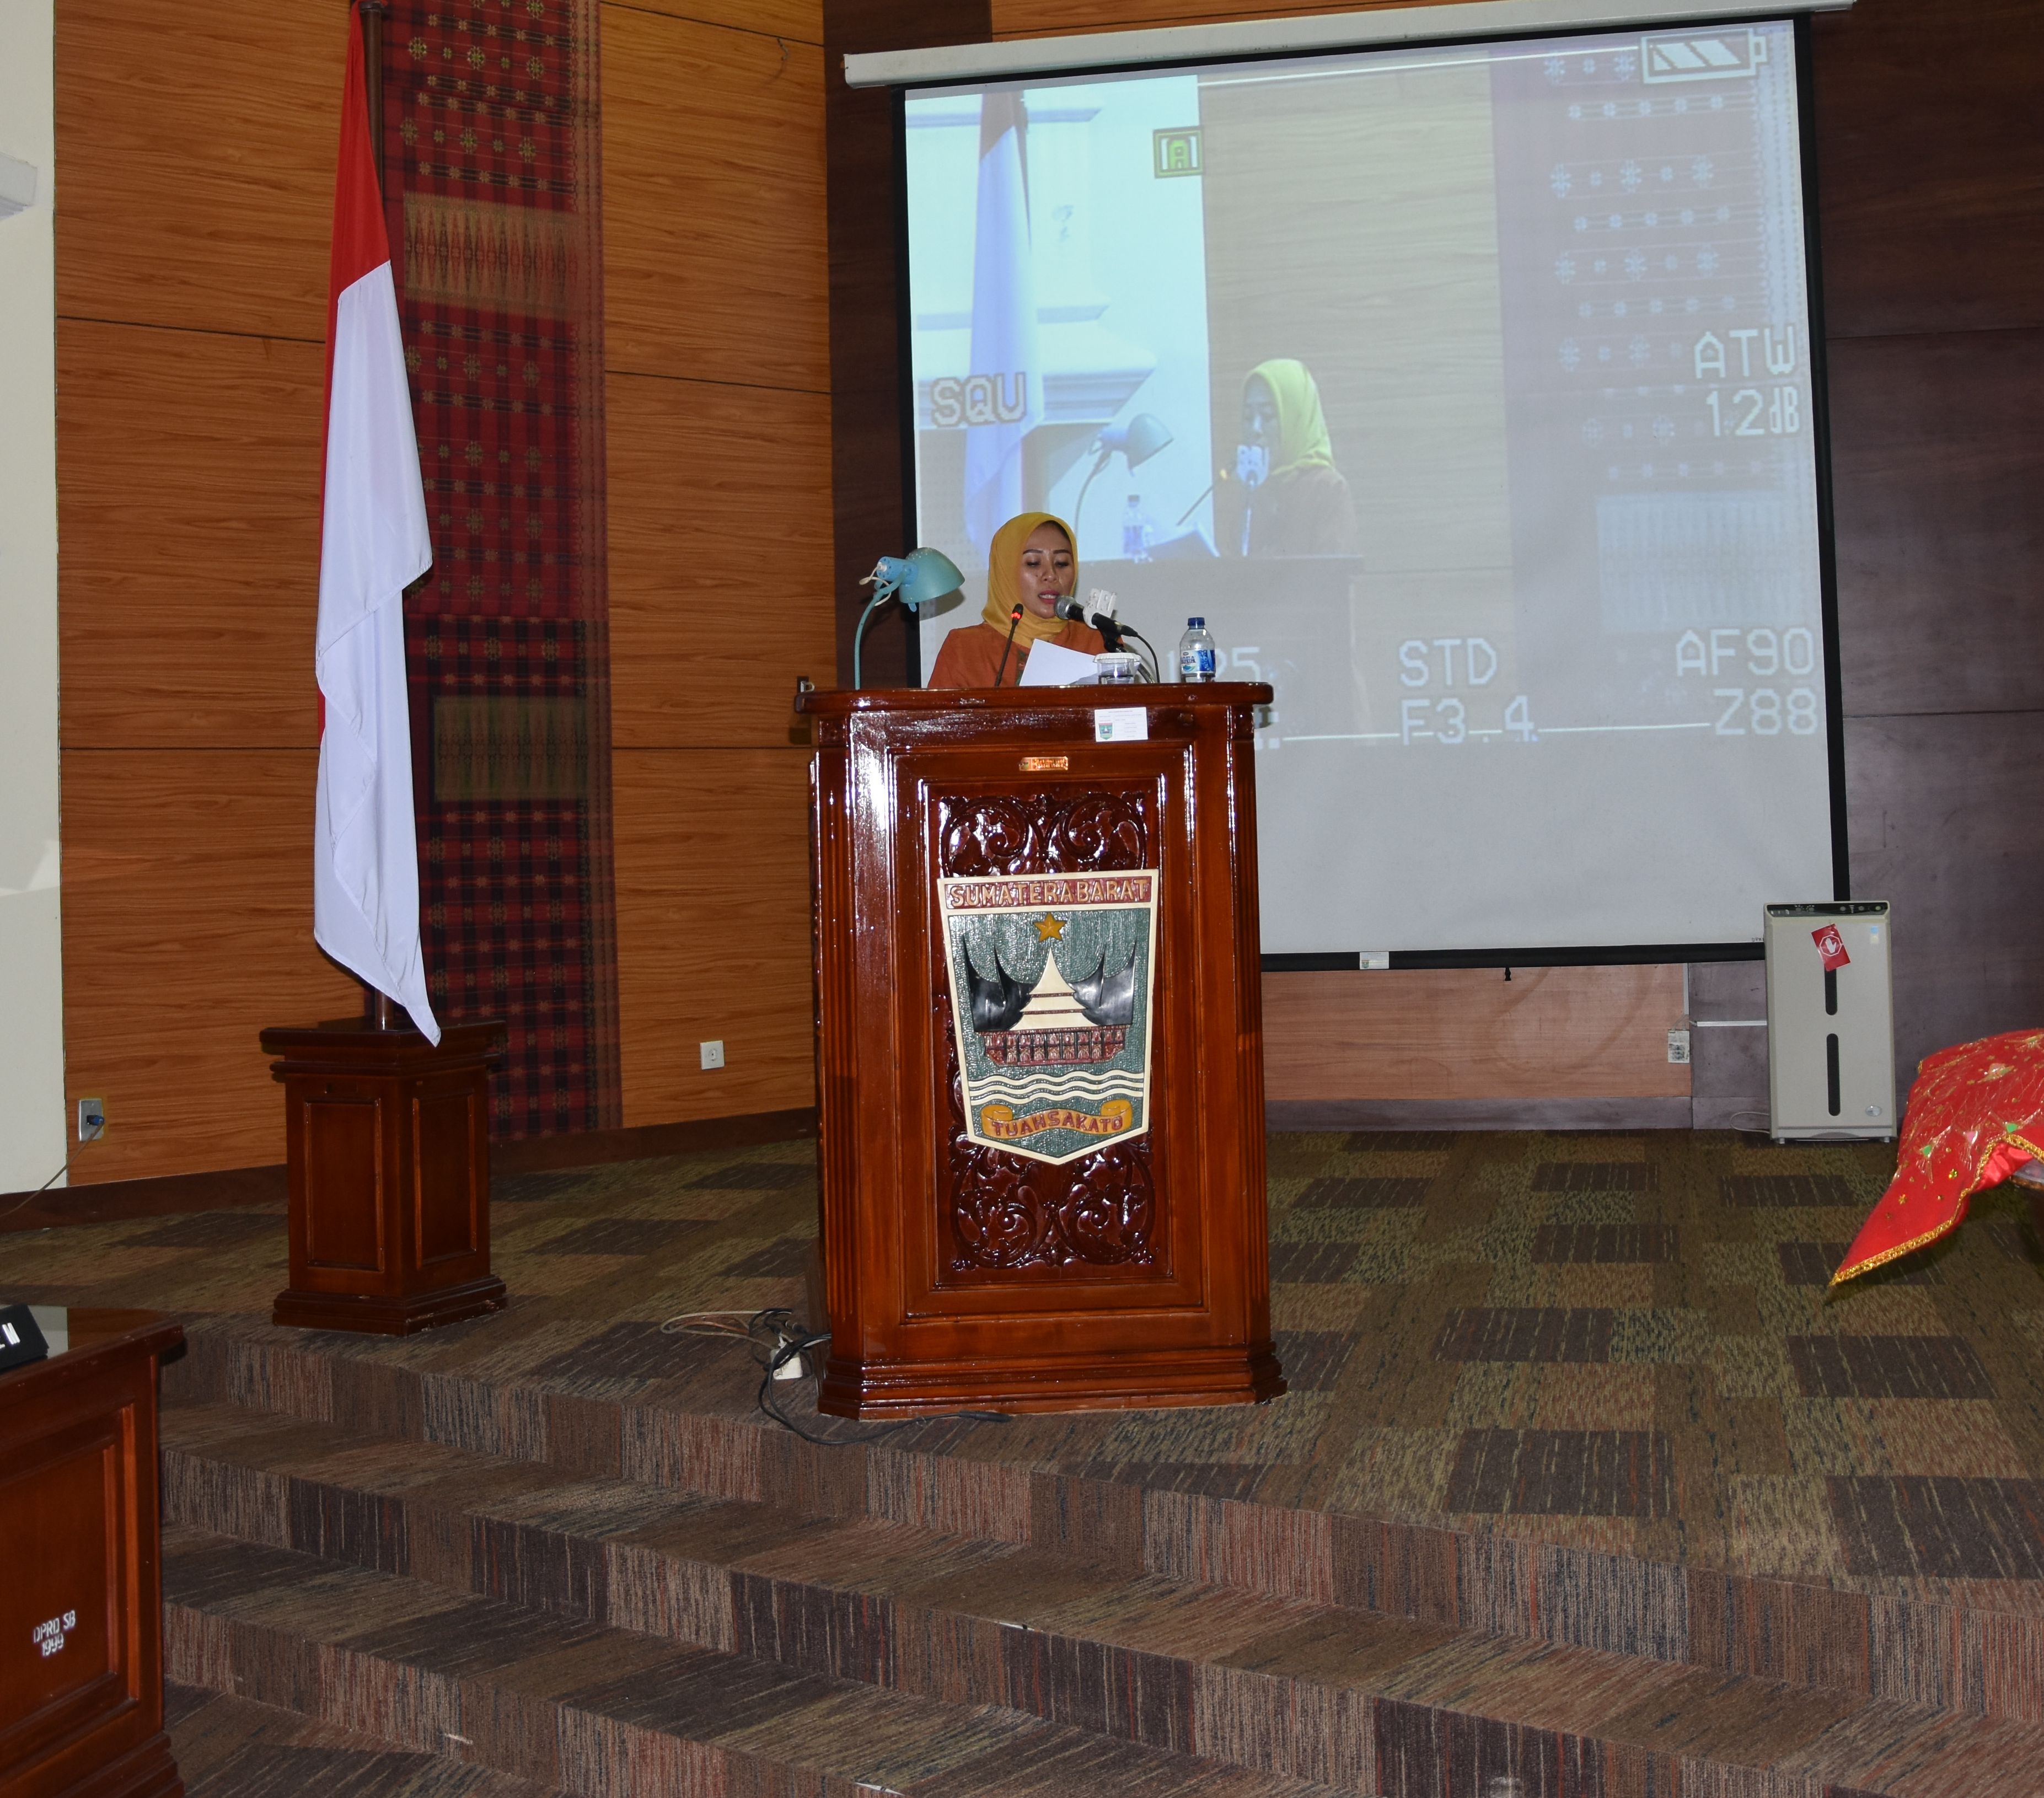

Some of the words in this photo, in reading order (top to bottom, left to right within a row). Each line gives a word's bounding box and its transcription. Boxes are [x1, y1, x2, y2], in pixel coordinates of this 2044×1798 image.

[1694, 326, 1795, 378] ATW
[932, 373, 1026, 426] SQU
[1399, 638, 1497, 686] STD
[1676, 627, 1813, 676] AF90
[1713, 688, 1818, 736] Z88
[33, 1618, 60, 1643] DPRD
[63, 1610, 76, 1629] SB
[42, 1633, 64, 1656] 1999
